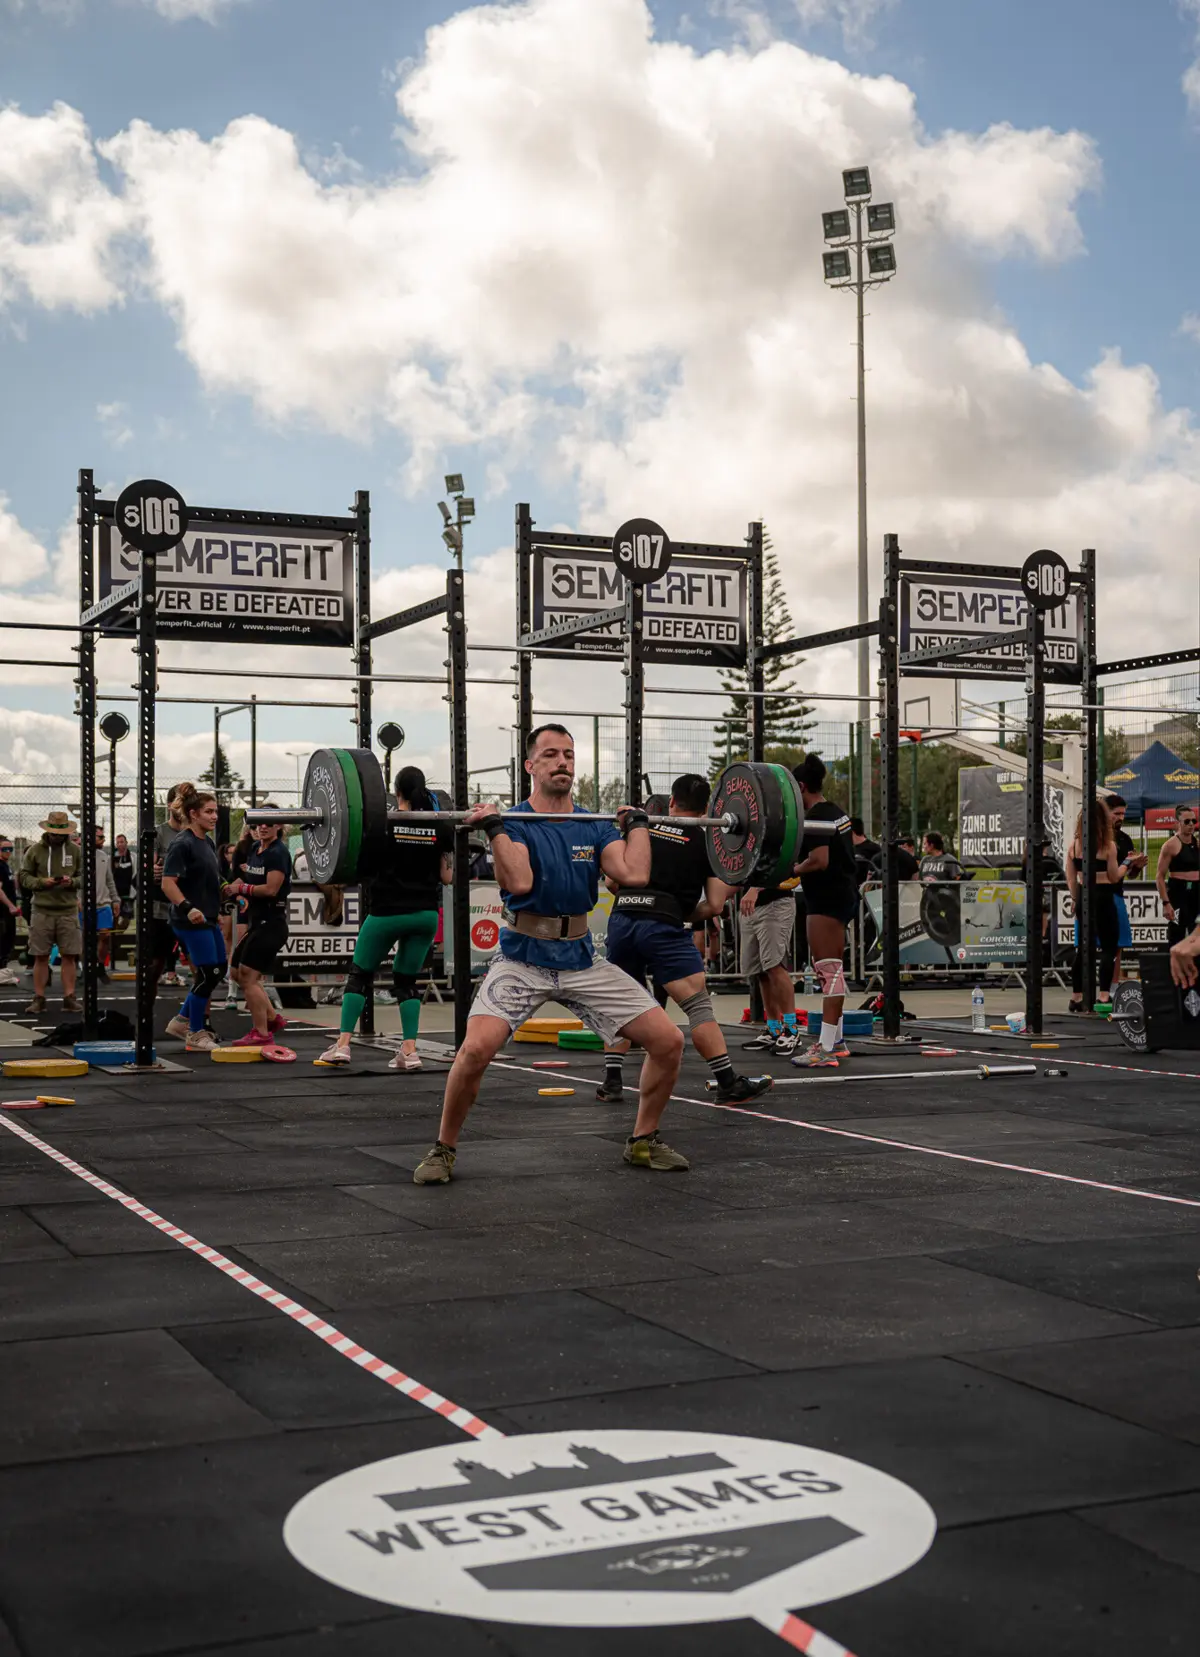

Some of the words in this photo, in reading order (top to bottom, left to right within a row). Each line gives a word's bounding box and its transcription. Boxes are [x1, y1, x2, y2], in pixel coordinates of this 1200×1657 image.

[146, 497, 180, 535] 06
[636, 534, 664, 569] 07
[551, 563, 732, 608] SEMERFIT
[1041, 564, 1065, 597] 08
[200, 591, 227, 612] BE
[234, 593, 341, 617] DEFEATED
[243, 623, 311, 633] www.semperfit.pt
[650, 619, 737, 641] DEFEATED
[655, 647, 712, 656] www.semperfit.pt
[725, 776, 759, 824] SEMPERFIT
[393, 826, 436, 836] FERRETTI
[653, 823, 684, 836] JESSE
[962, 814, 986, 834] ZONA
[988, 813, 1002, 832] DE
[962, 836, 1026, 856] AQUECIMENT
[617, 896, 655, 905] ROGUE
[977, 887, 1025, 905] ERG
[322, 938, 341, 953] BE
[346, 1502, 566, 1555] WEST
[579, 1469, 846, 1522] GAMES
